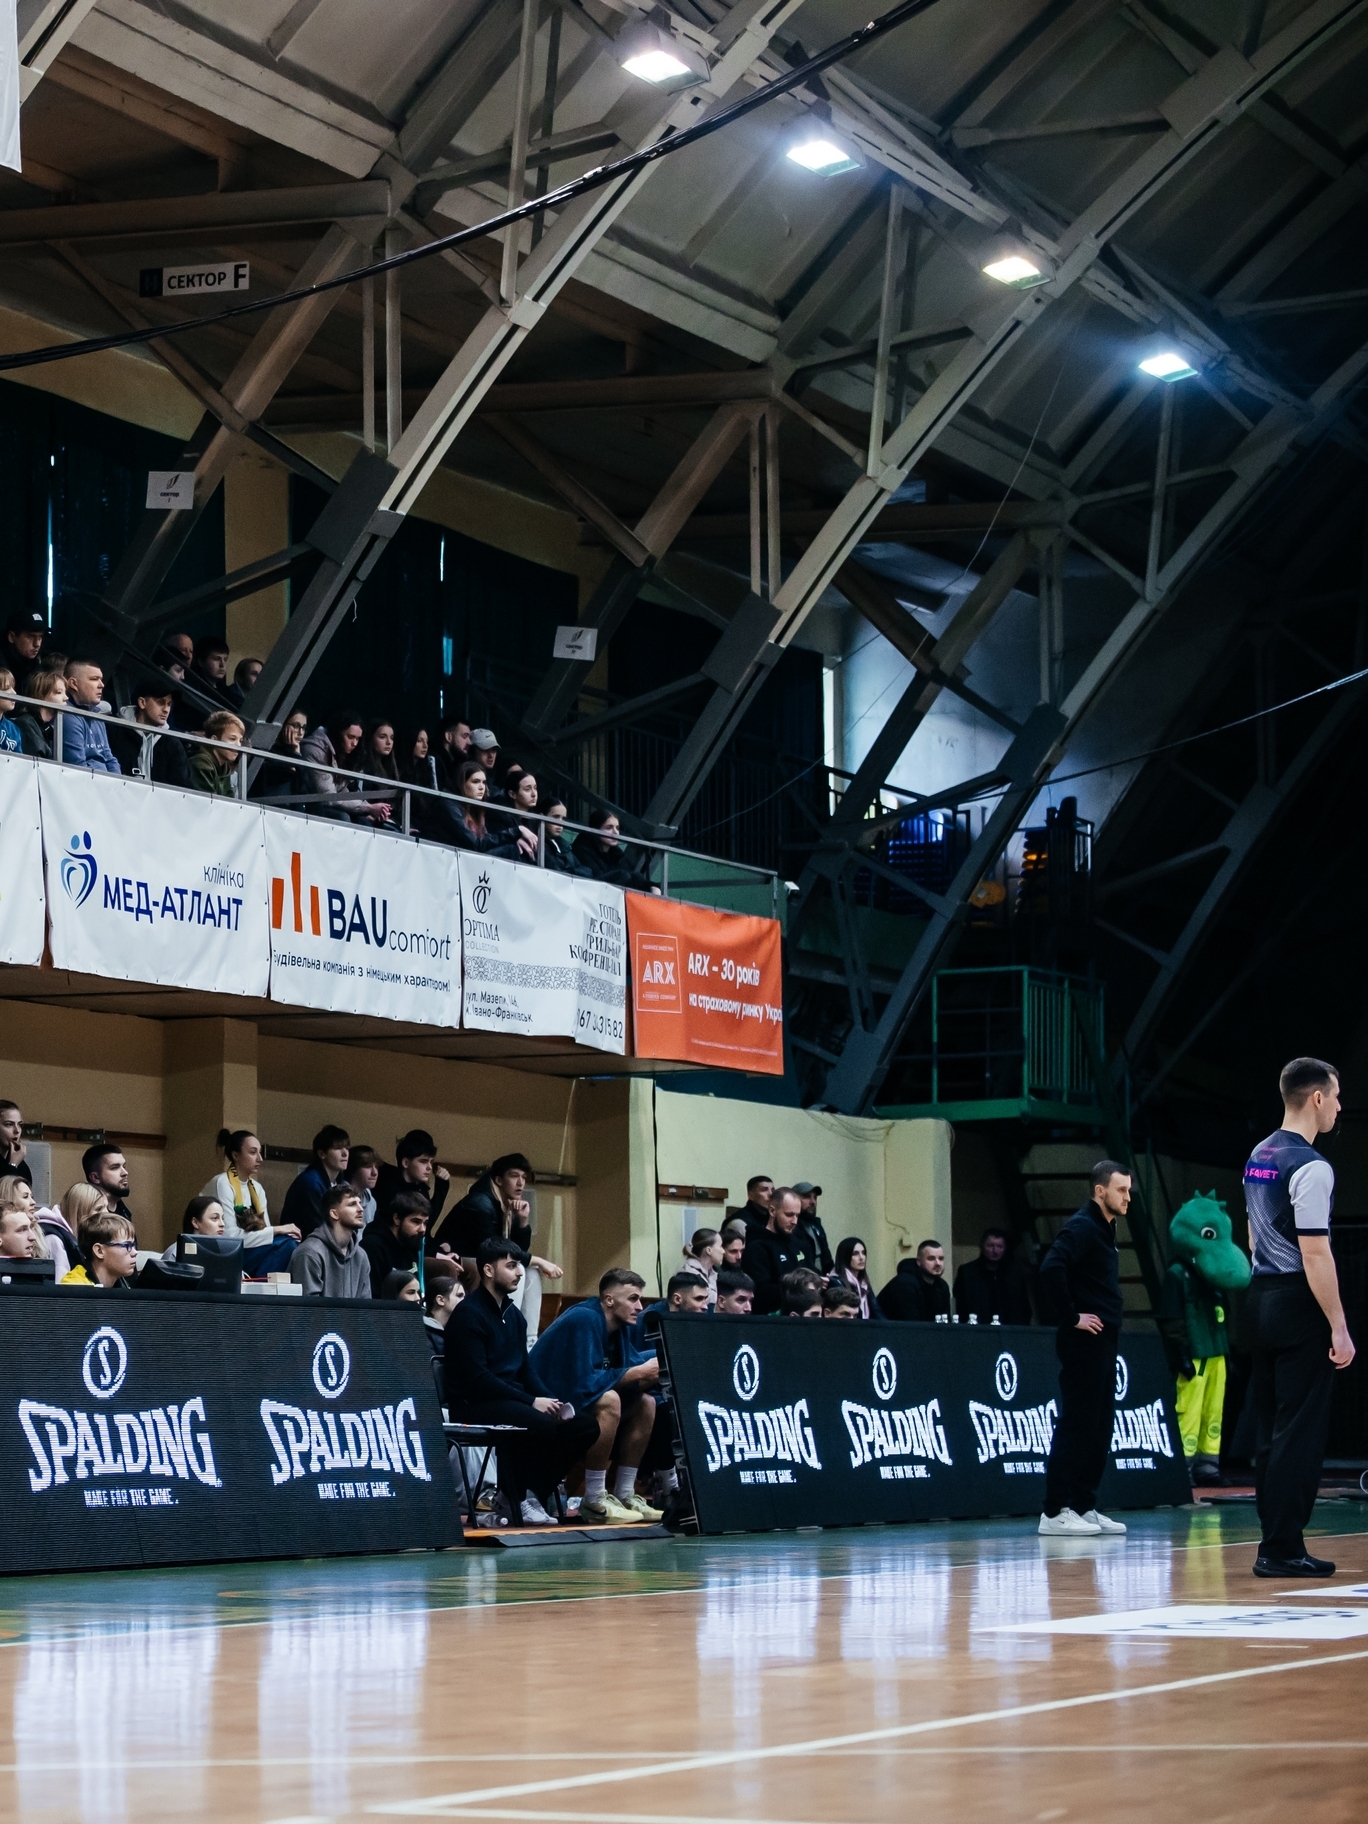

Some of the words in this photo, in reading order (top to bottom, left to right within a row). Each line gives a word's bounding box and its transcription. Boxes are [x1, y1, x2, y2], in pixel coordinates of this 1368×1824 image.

[167, 272, 226, 289] СЕКТОР
[233, 264, 247, 288] F
[203, 863, 244, 888] клініка
[103, 873, 243, 931] МЕД-АТЛАНТ
[642, 960, 676, 985] ARX
[688, 952, 710, 977] ARX
[721, 958, 735, 981] 30
[736, 962, 761, 989] років
[613, 1020, 623, 1038] 82
[689, 993, 697, 1007] на
[698, 995, 741, 1019] страховому
[18, 1397, 221, 1492] SPALDING
[260, 1398, 431, 1486] SPALDING
[698, 1399, 822, 1473] SPALDING
[841, 1399, 952, 1468] SPALDING
[1110, 1399, 1174, 1457] ALDING
